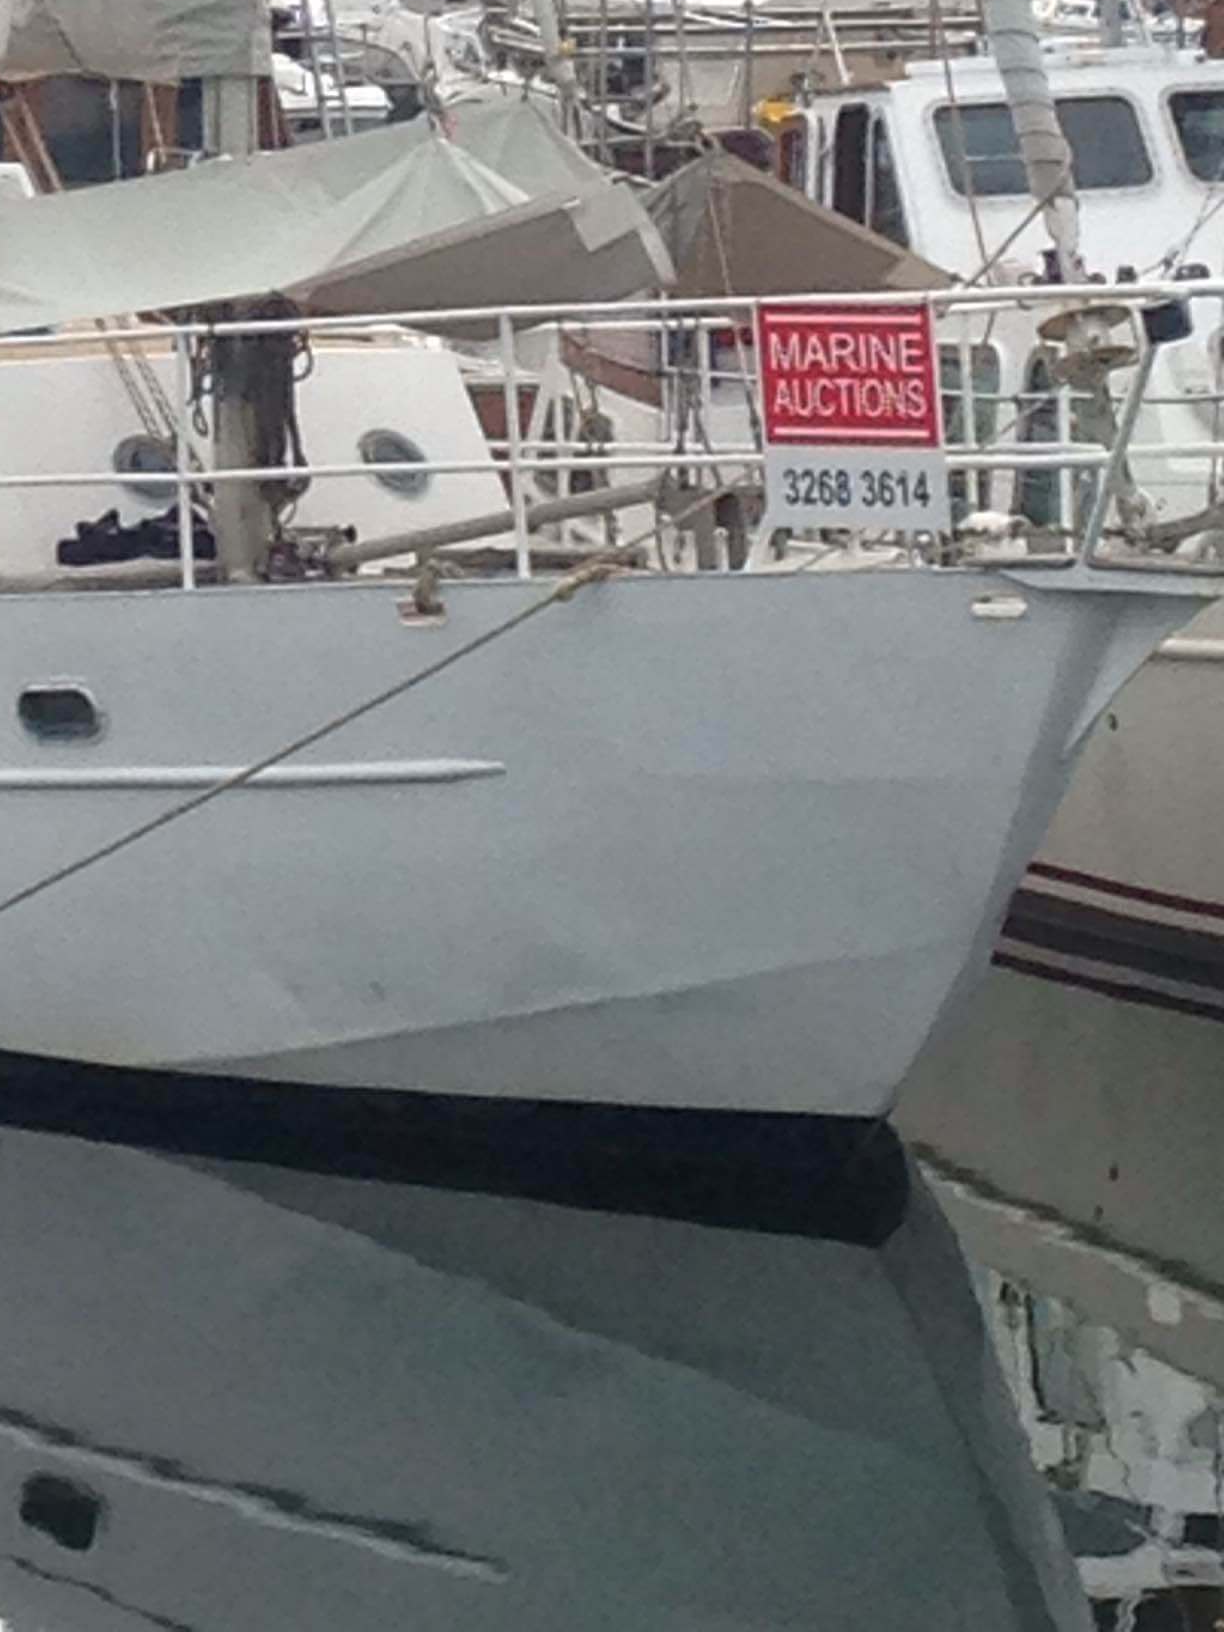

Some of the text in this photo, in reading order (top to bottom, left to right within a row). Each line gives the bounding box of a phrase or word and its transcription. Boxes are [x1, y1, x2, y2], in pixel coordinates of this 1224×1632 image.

[769, 332, 924, 373] MARINE
[774, 378, 927, 418] AUCTIONS
[783, 468, 930, 508] 3268 3614
